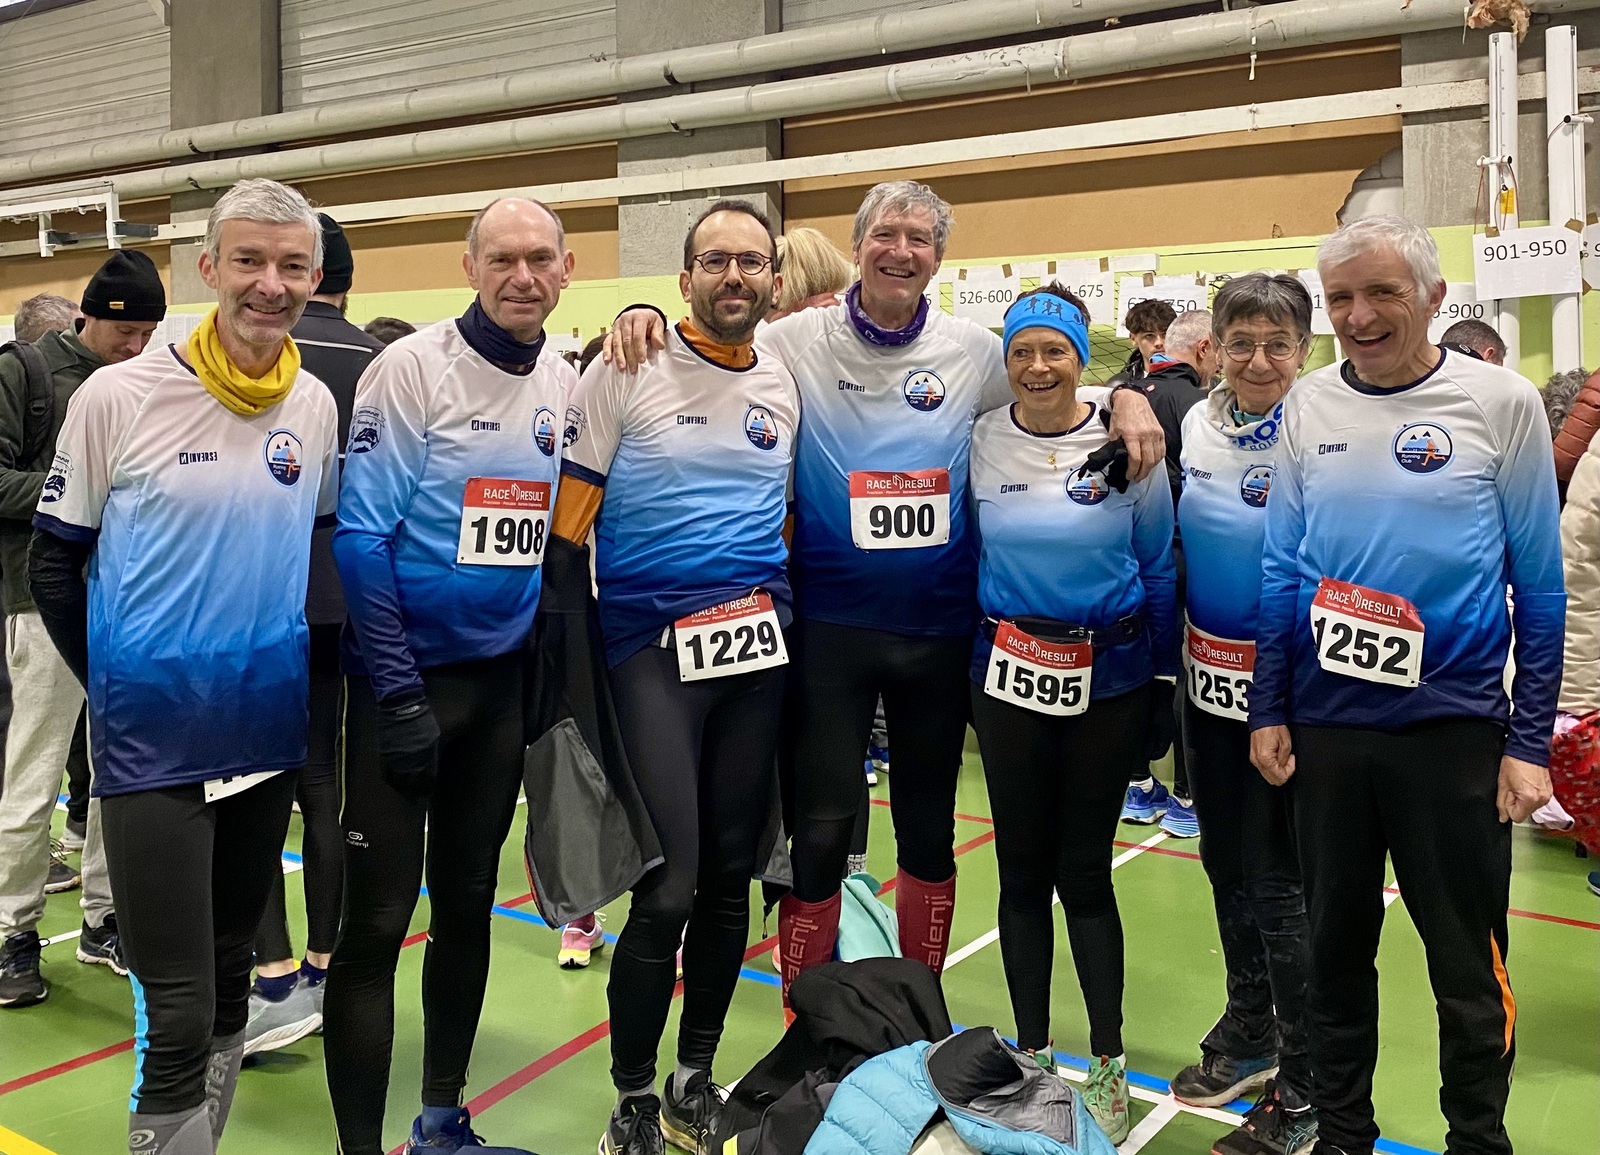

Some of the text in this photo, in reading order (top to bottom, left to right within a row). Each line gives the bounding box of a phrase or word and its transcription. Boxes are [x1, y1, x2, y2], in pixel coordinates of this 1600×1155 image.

[1484, 239, 1567, 262] 901-950
[960, 290, 1013, 304] 526-600
[190, 452, 218, 463] INVERSE
[484, 488, 544, 502] RACE RESULT
[866, 478, 936, 489] RACE RESULT
[870, 504, 935, 539] 900
[470, 516, 545, 556] 1908
[730, 596, 759, 610] RESULT
[1327, 589, 1404, 618] RACE RESULT
[685, 621, 778, 670] 1229
[1007, 636, 1029, 653] RACE
[1041, 650, 1078, 662] RESULT
[1211, 649, 1243, 663] RESULT
[1314, 616, 1411, 676] 1252
[996, 659, 1082, 707] 1595
[1190, 664, 1252, 712] 1253
[921, 895, 952, 972] alenji
